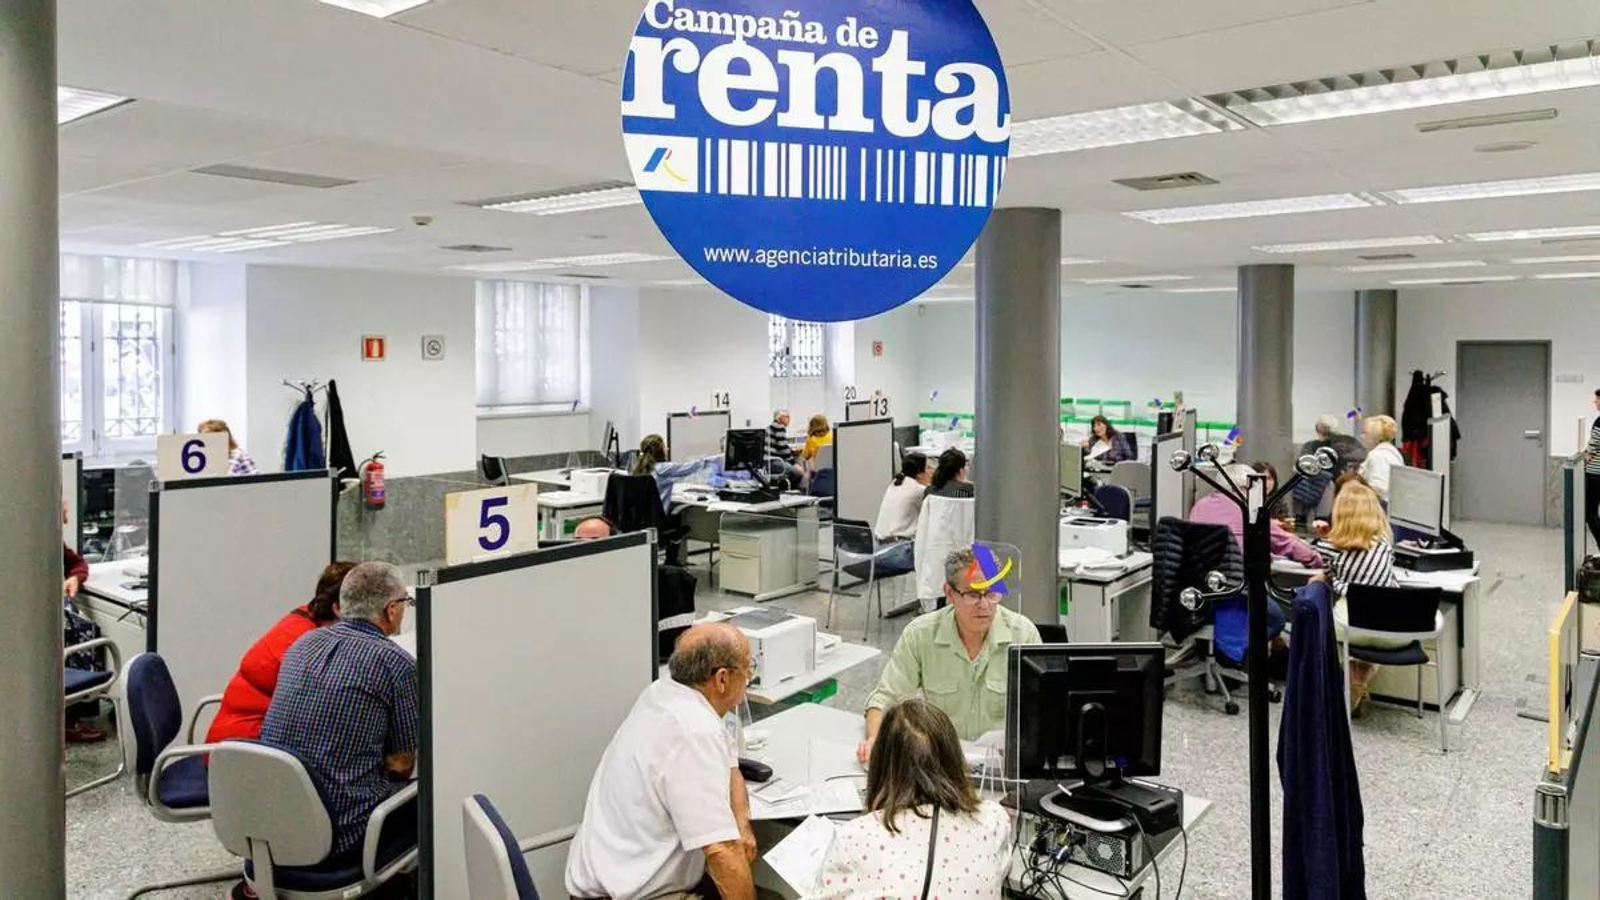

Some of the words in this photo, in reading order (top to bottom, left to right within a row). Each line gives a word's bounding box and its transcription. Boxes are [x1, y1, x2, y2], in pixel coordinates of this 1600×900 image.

[644, 0, 827, 46] Campaña
[836, 17, 879, 48] de
[621, 30, 1011, 143] renta
[703, 246, 938, 269] www.agenciatributaria.es
[714, 393, 730, 407] 14
[844, 386, 857, 400] 20
[873, 397, 888, 417] 13
[181, 439, 207, 474] 6
[478, 496, 510, 551] 5
